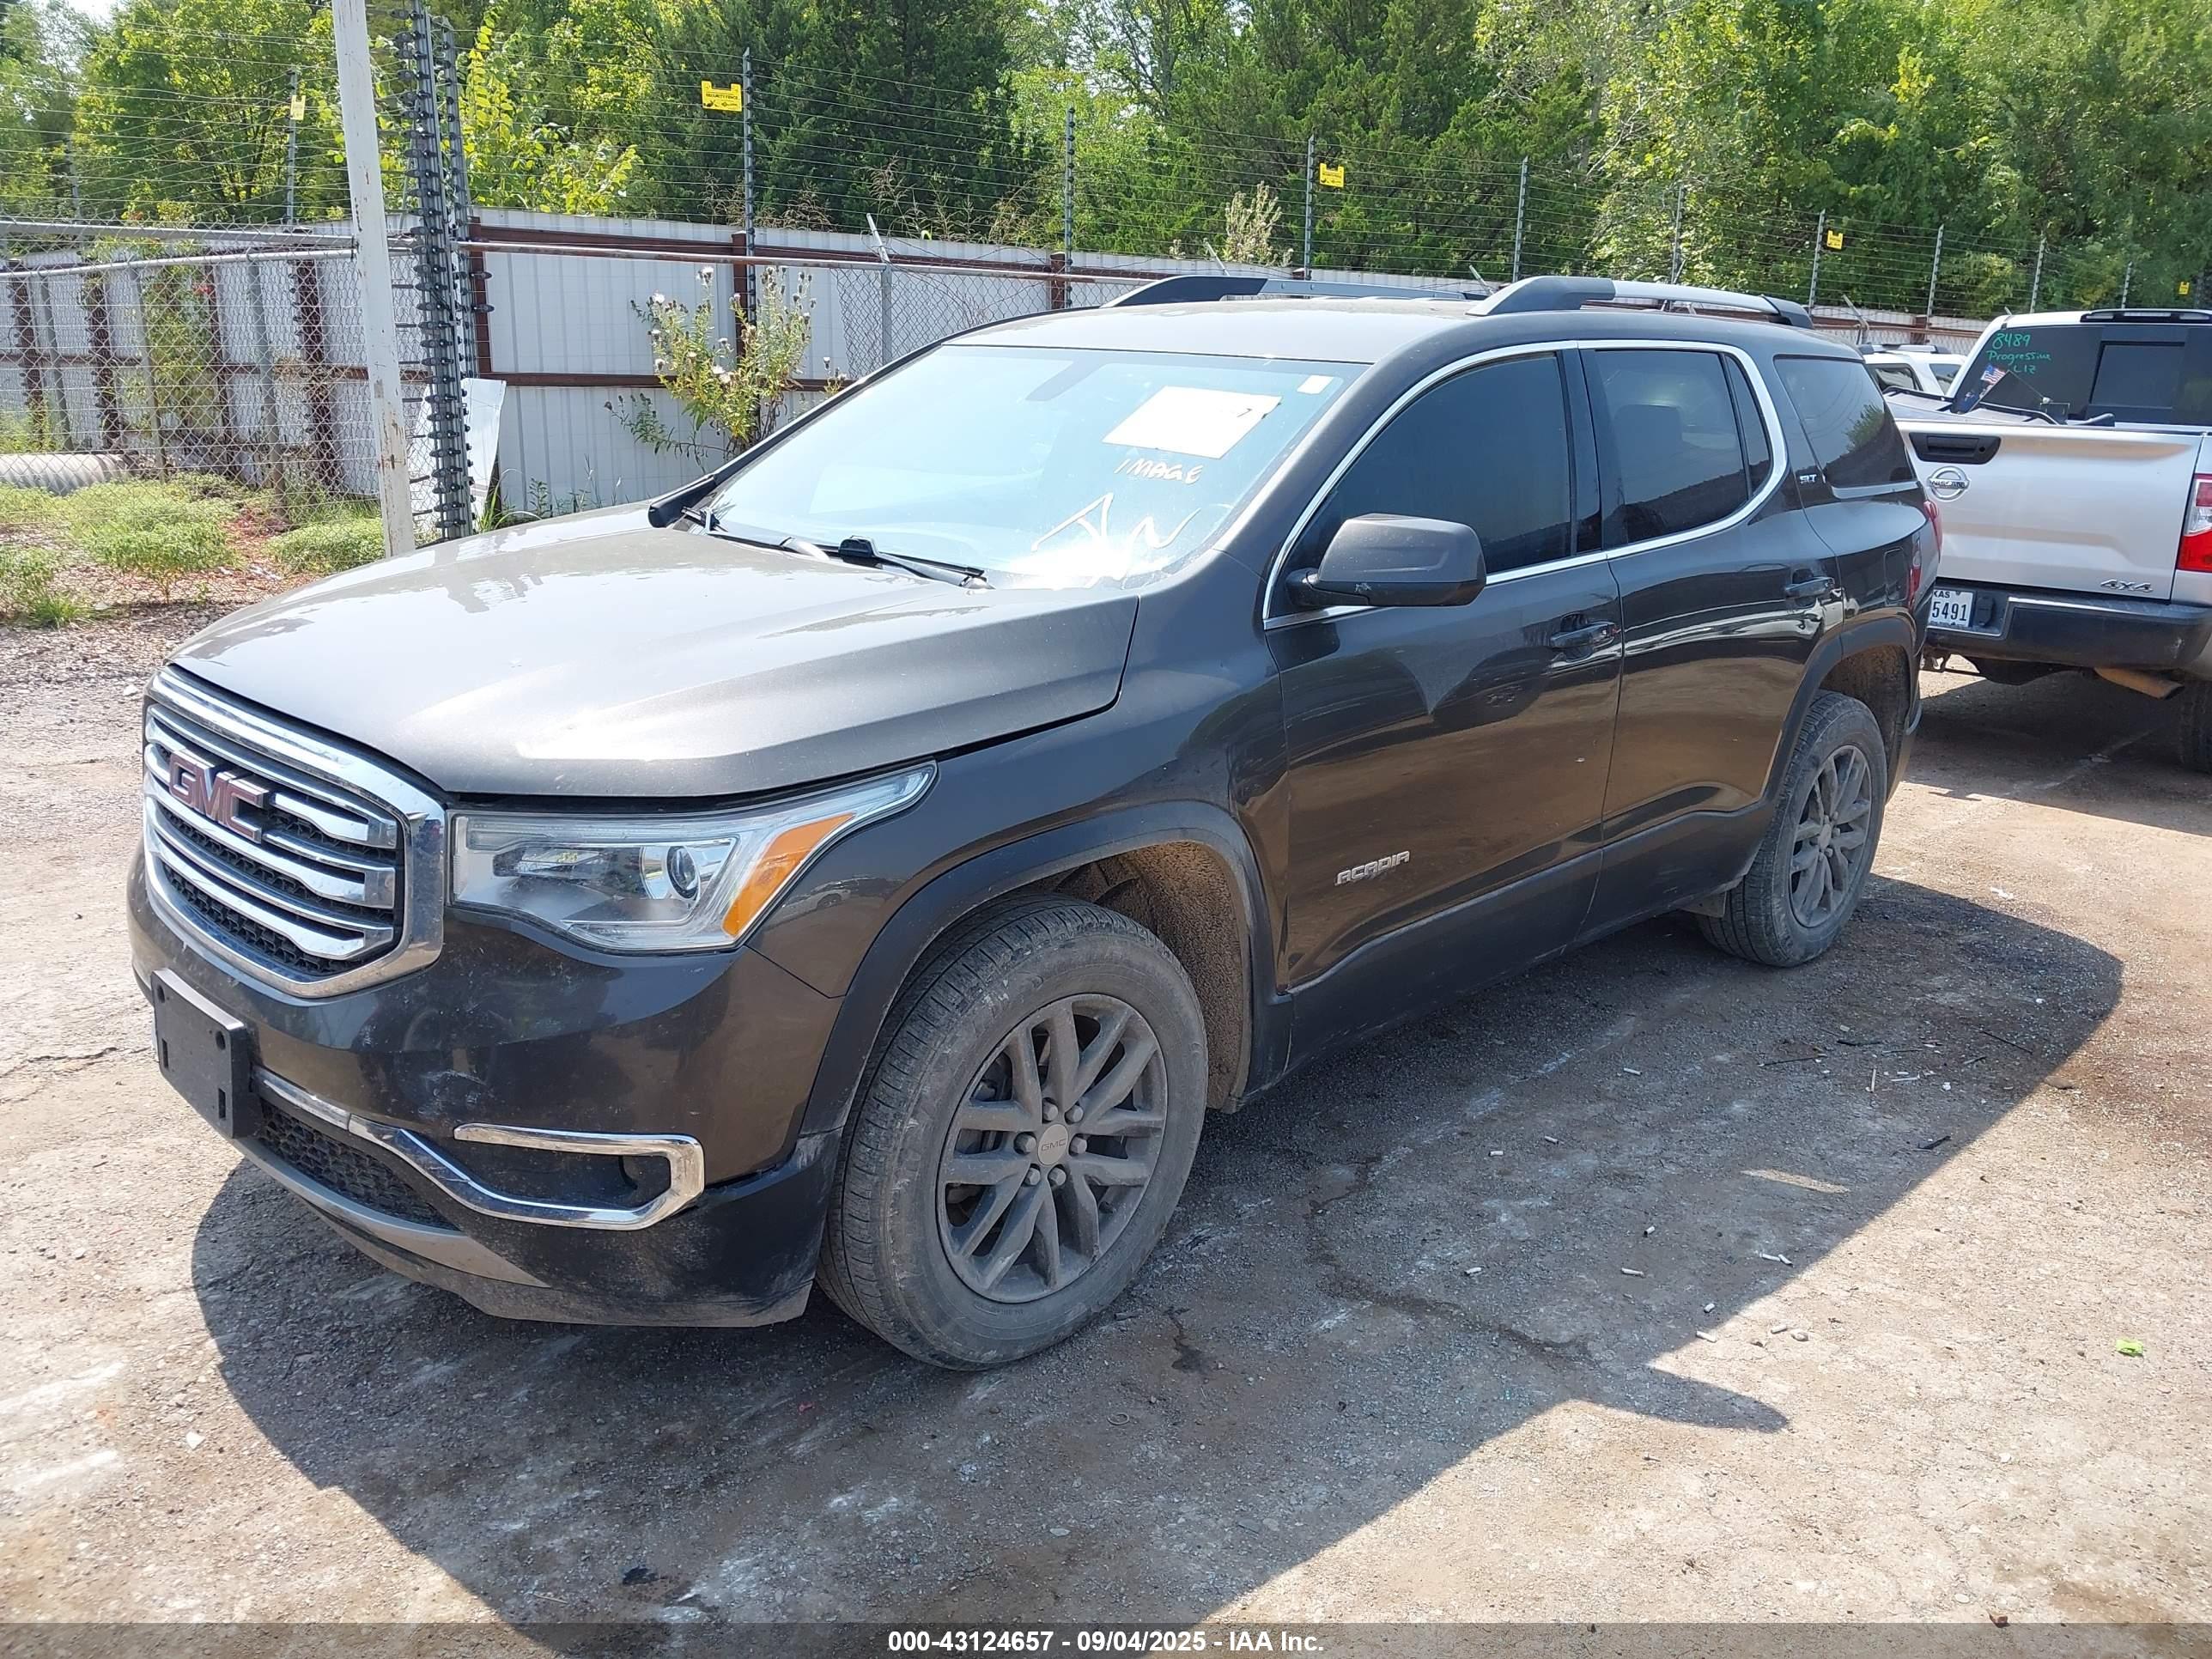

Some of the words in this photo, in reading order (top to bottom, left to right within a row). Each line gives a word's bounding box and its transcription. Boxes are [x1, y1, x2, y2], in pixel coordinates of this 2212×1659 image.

[1992, 333, 2032, 349] 8489
[1931, 601, 1967, 622] 5491
[169, 750, 267, 844] GMC
[1334, 850, 1410, 886] ACADIA
[1041, 1138, 1066, 1152] GMC
